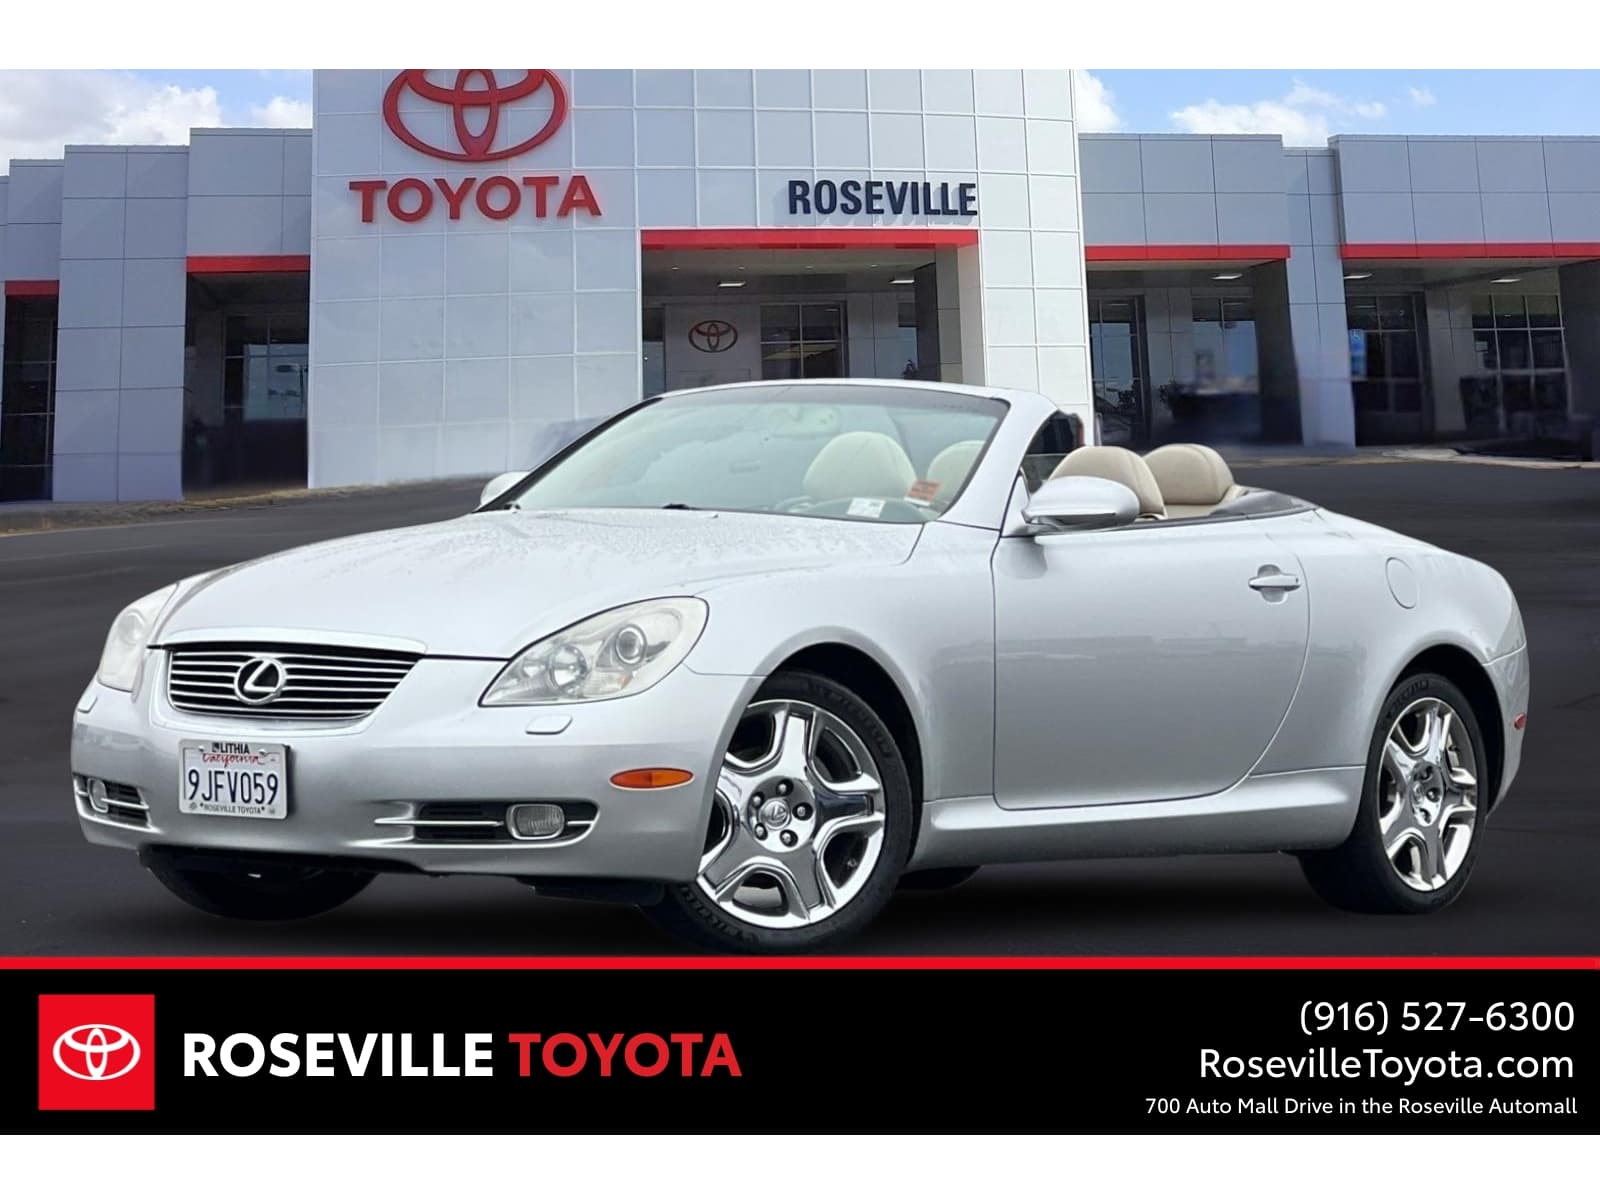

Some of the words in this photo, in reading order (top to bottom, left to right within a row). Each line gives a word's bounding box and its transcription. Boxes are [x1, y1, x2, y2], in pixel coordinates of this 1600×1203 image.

[349, 175, 602, 223] TOYOTA
[788, 180, 978, 216] ROSEVILLE
[220, 742, 250, 754] LITHIA
[188, 769, 279, 806] 9JFV059
[238, 806, 261, 814] TOYOTA
